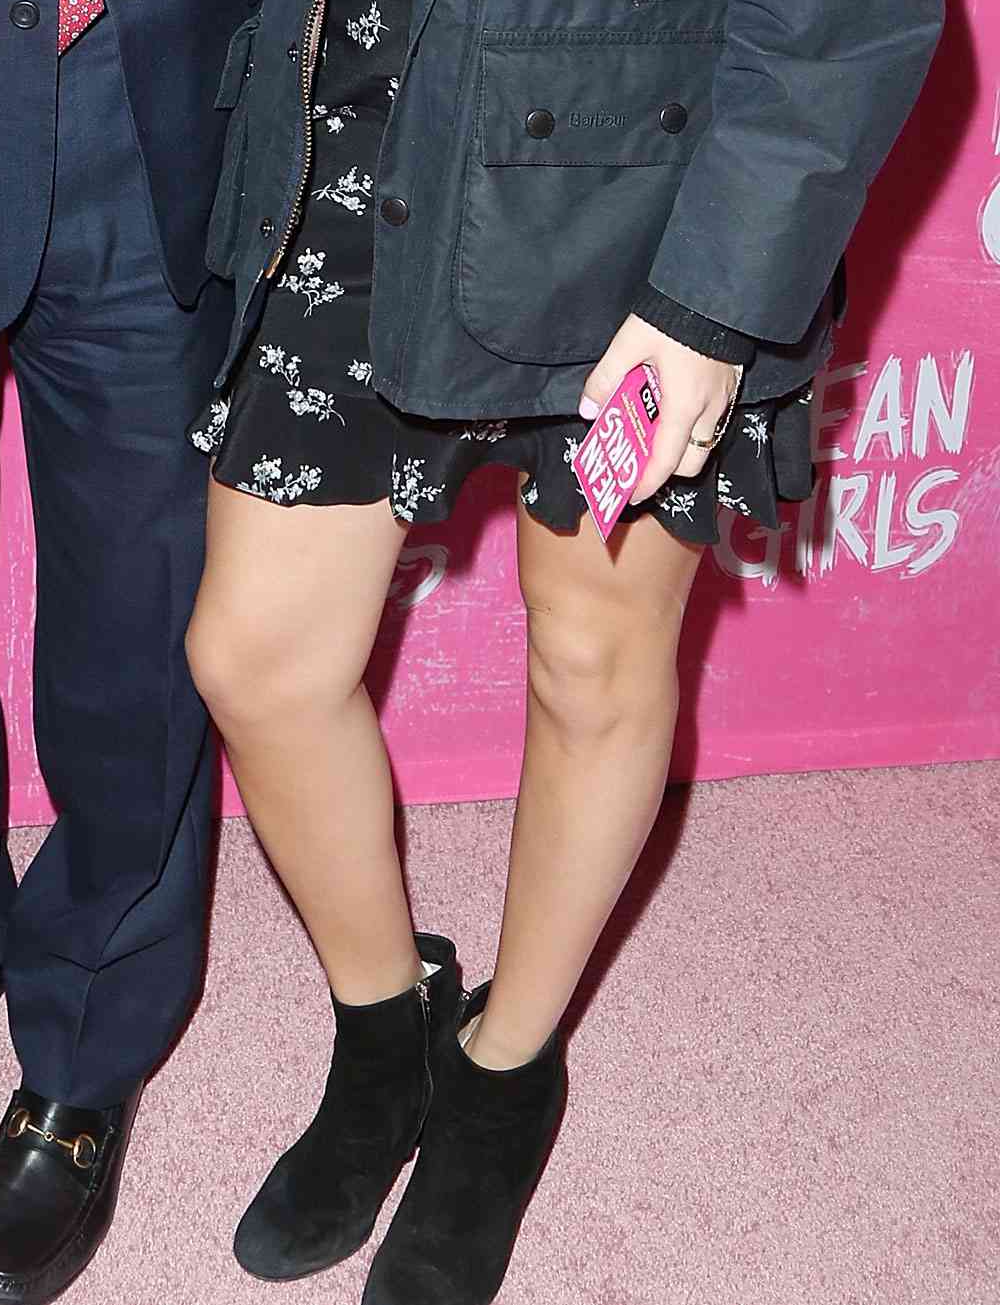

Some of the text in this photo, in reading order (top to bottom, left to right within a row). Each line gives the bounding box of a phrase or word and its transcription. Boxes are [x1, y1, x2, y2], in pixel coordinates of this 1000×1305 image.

[568, 109, 628, 128] Barbour
[580, 434, 624, 523] MEAN
[599, 407, 639, 489] GIRLS
